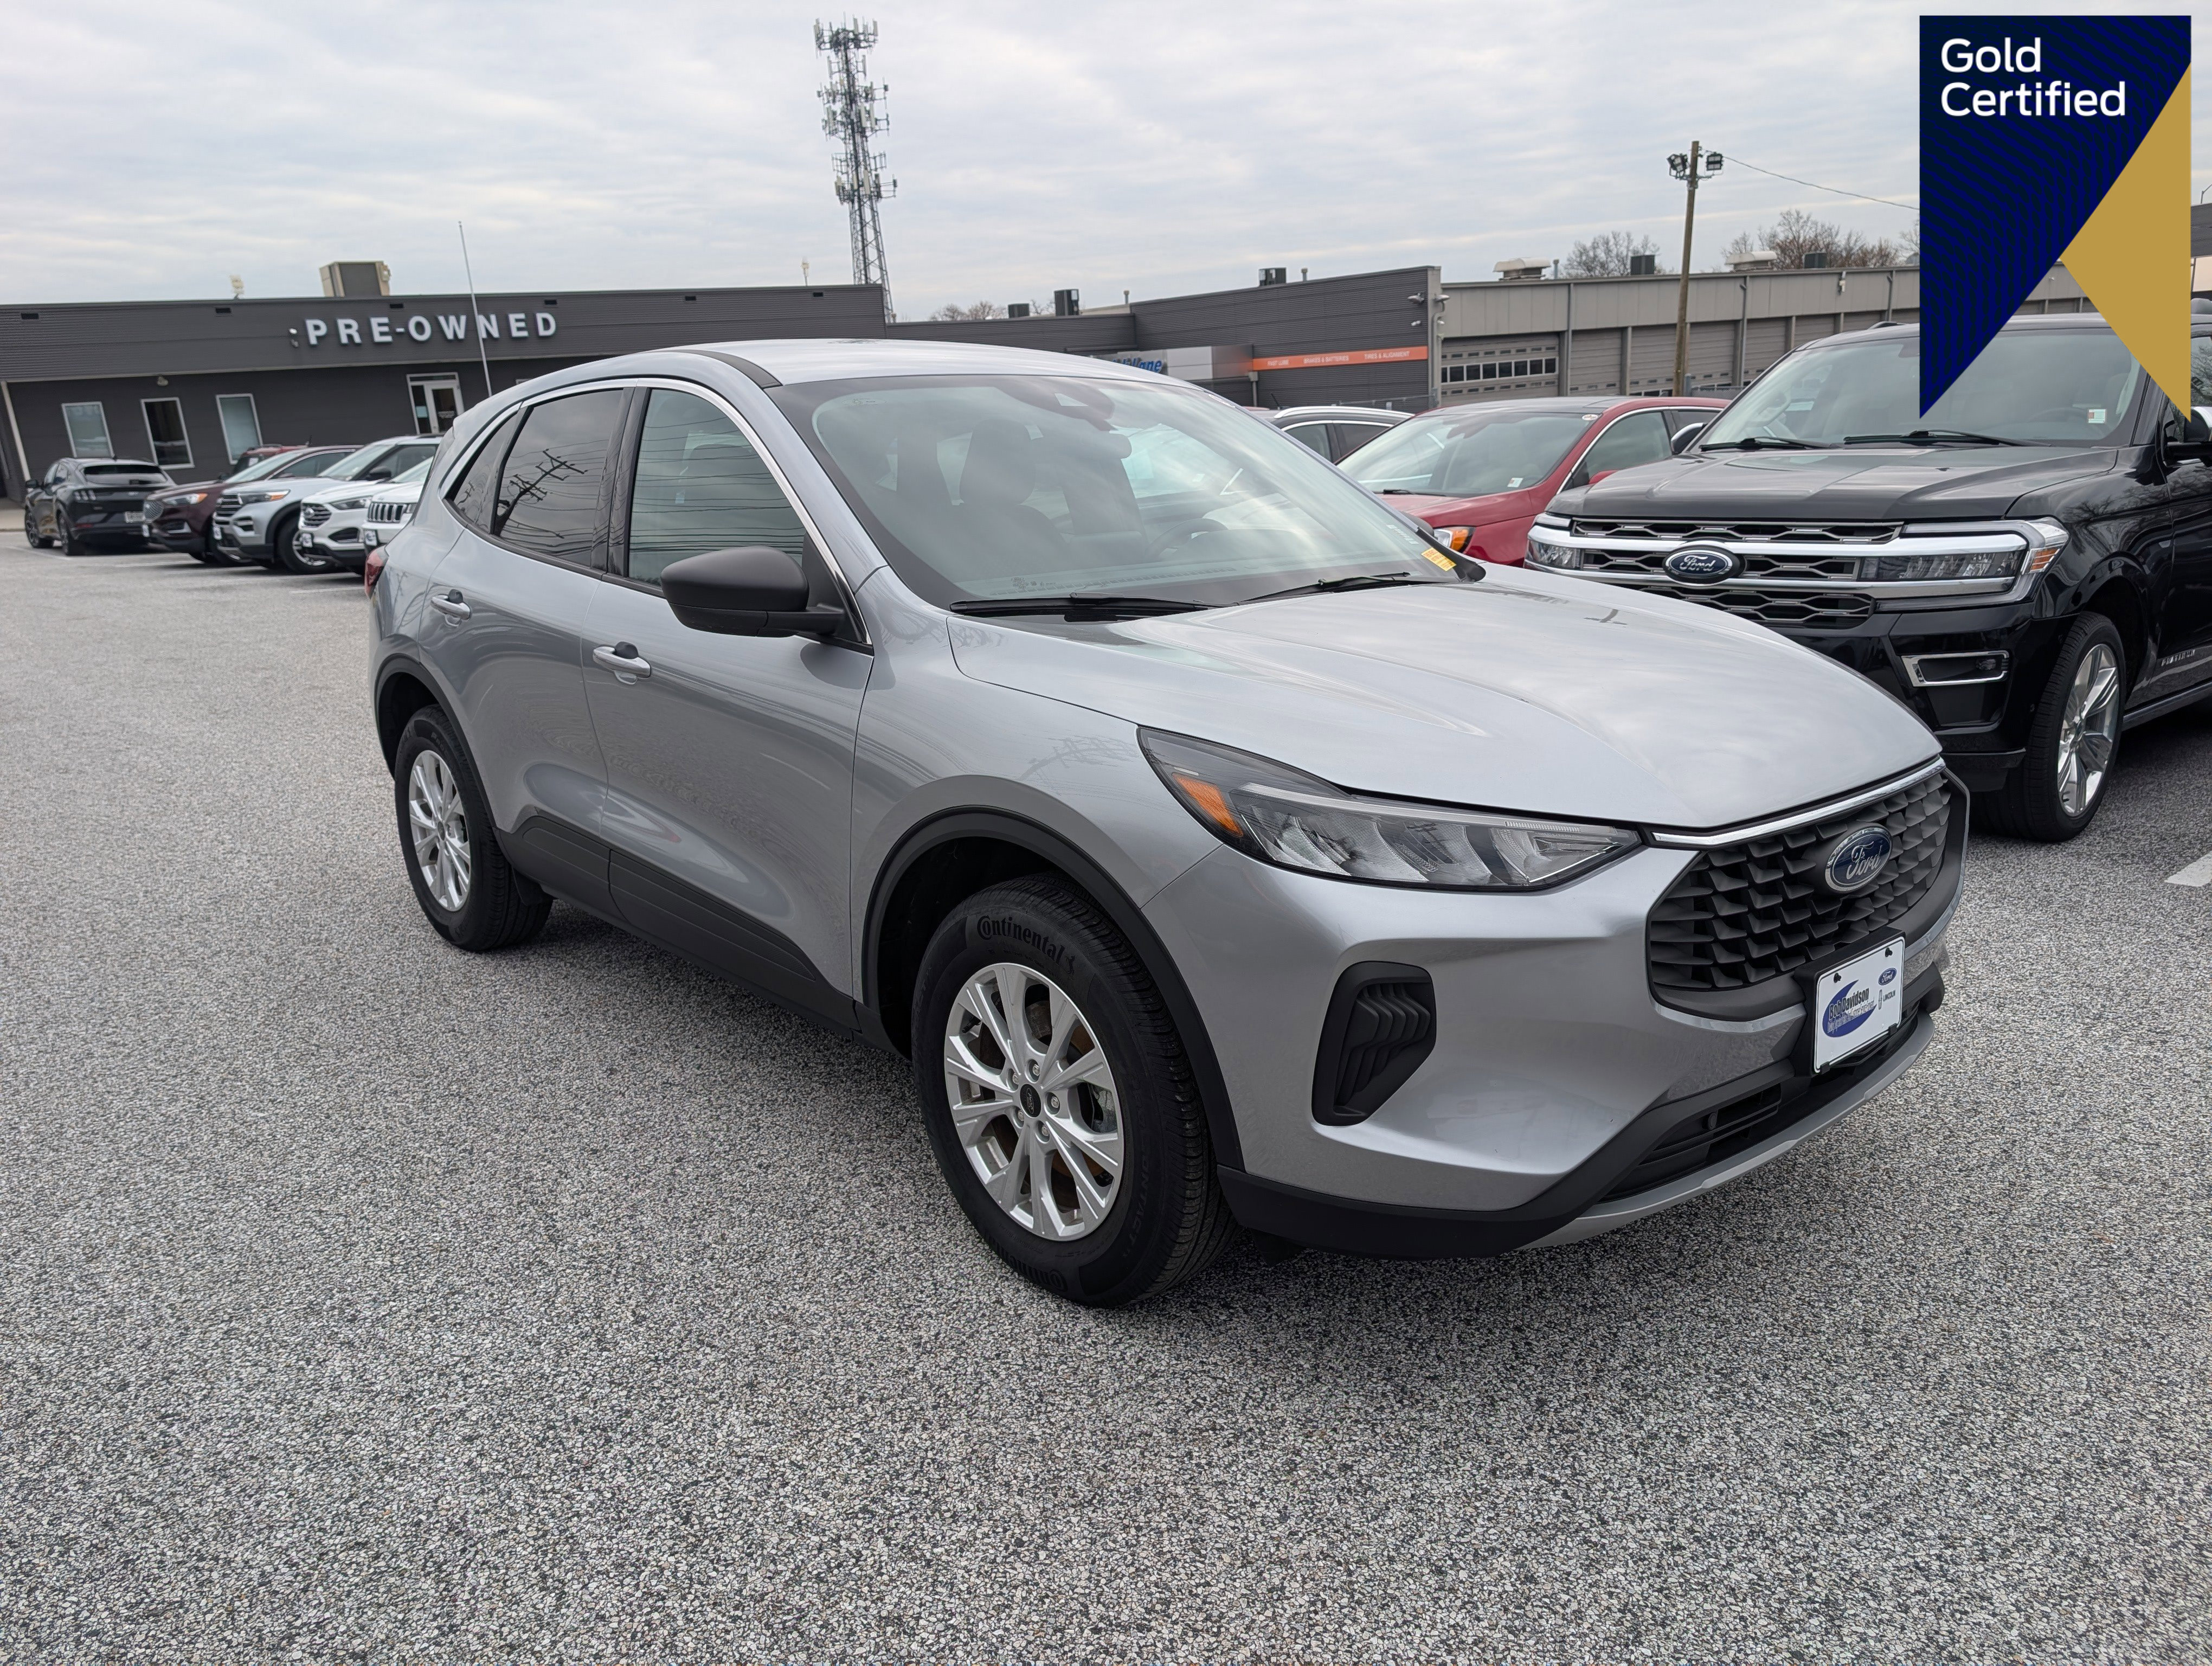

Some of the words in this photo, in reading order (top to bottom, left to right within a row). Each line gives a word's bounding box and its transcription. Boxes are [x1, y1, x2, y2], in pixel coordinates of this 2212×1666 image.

[305, 312, 557, 345] PRE-OWNED
[1679, 555, 1716, 571] Ford
[1846, 841, 1883, 880] Ford
[977, 915, 1065, 966] Continental
[1881, 970, 1894, 983] Ford
[1829, 999, 1842, 1020] Bob
[1842, 988, 1869, 1013] Davidson
[1883, 990, 1896, 1002] LINCOLN
